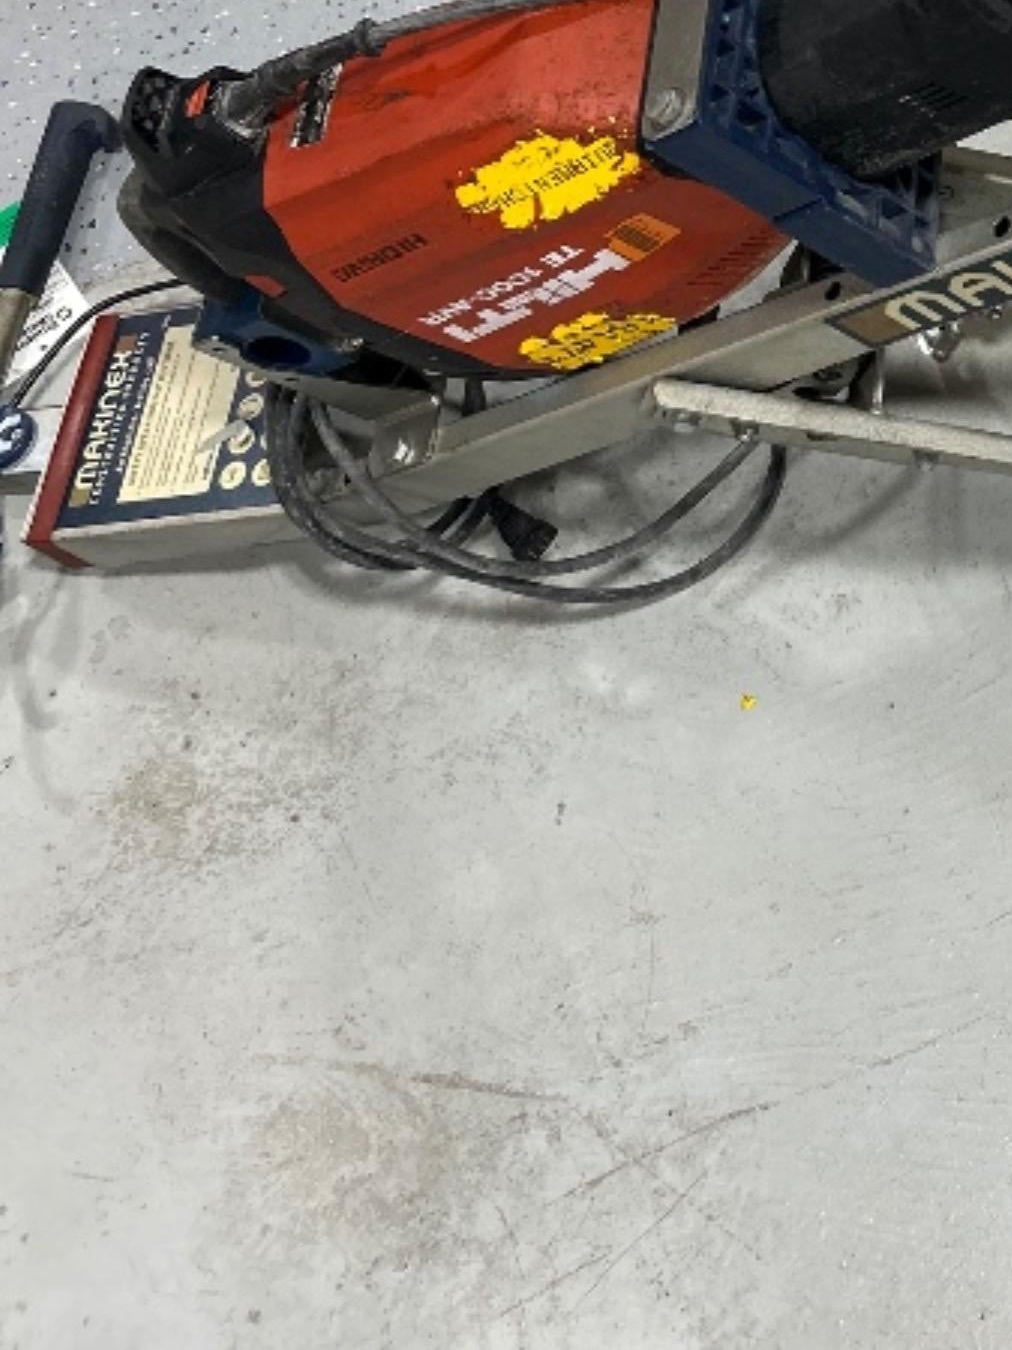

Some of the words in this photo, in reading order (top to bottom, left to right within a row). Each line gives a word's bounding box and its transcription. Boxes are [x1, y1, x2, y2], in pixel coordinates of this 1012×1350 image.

[442, 248, 632, 343] HILTI
[539, 244, 585, 268] TE
[73, 349, 134, 491] MAKINEX
